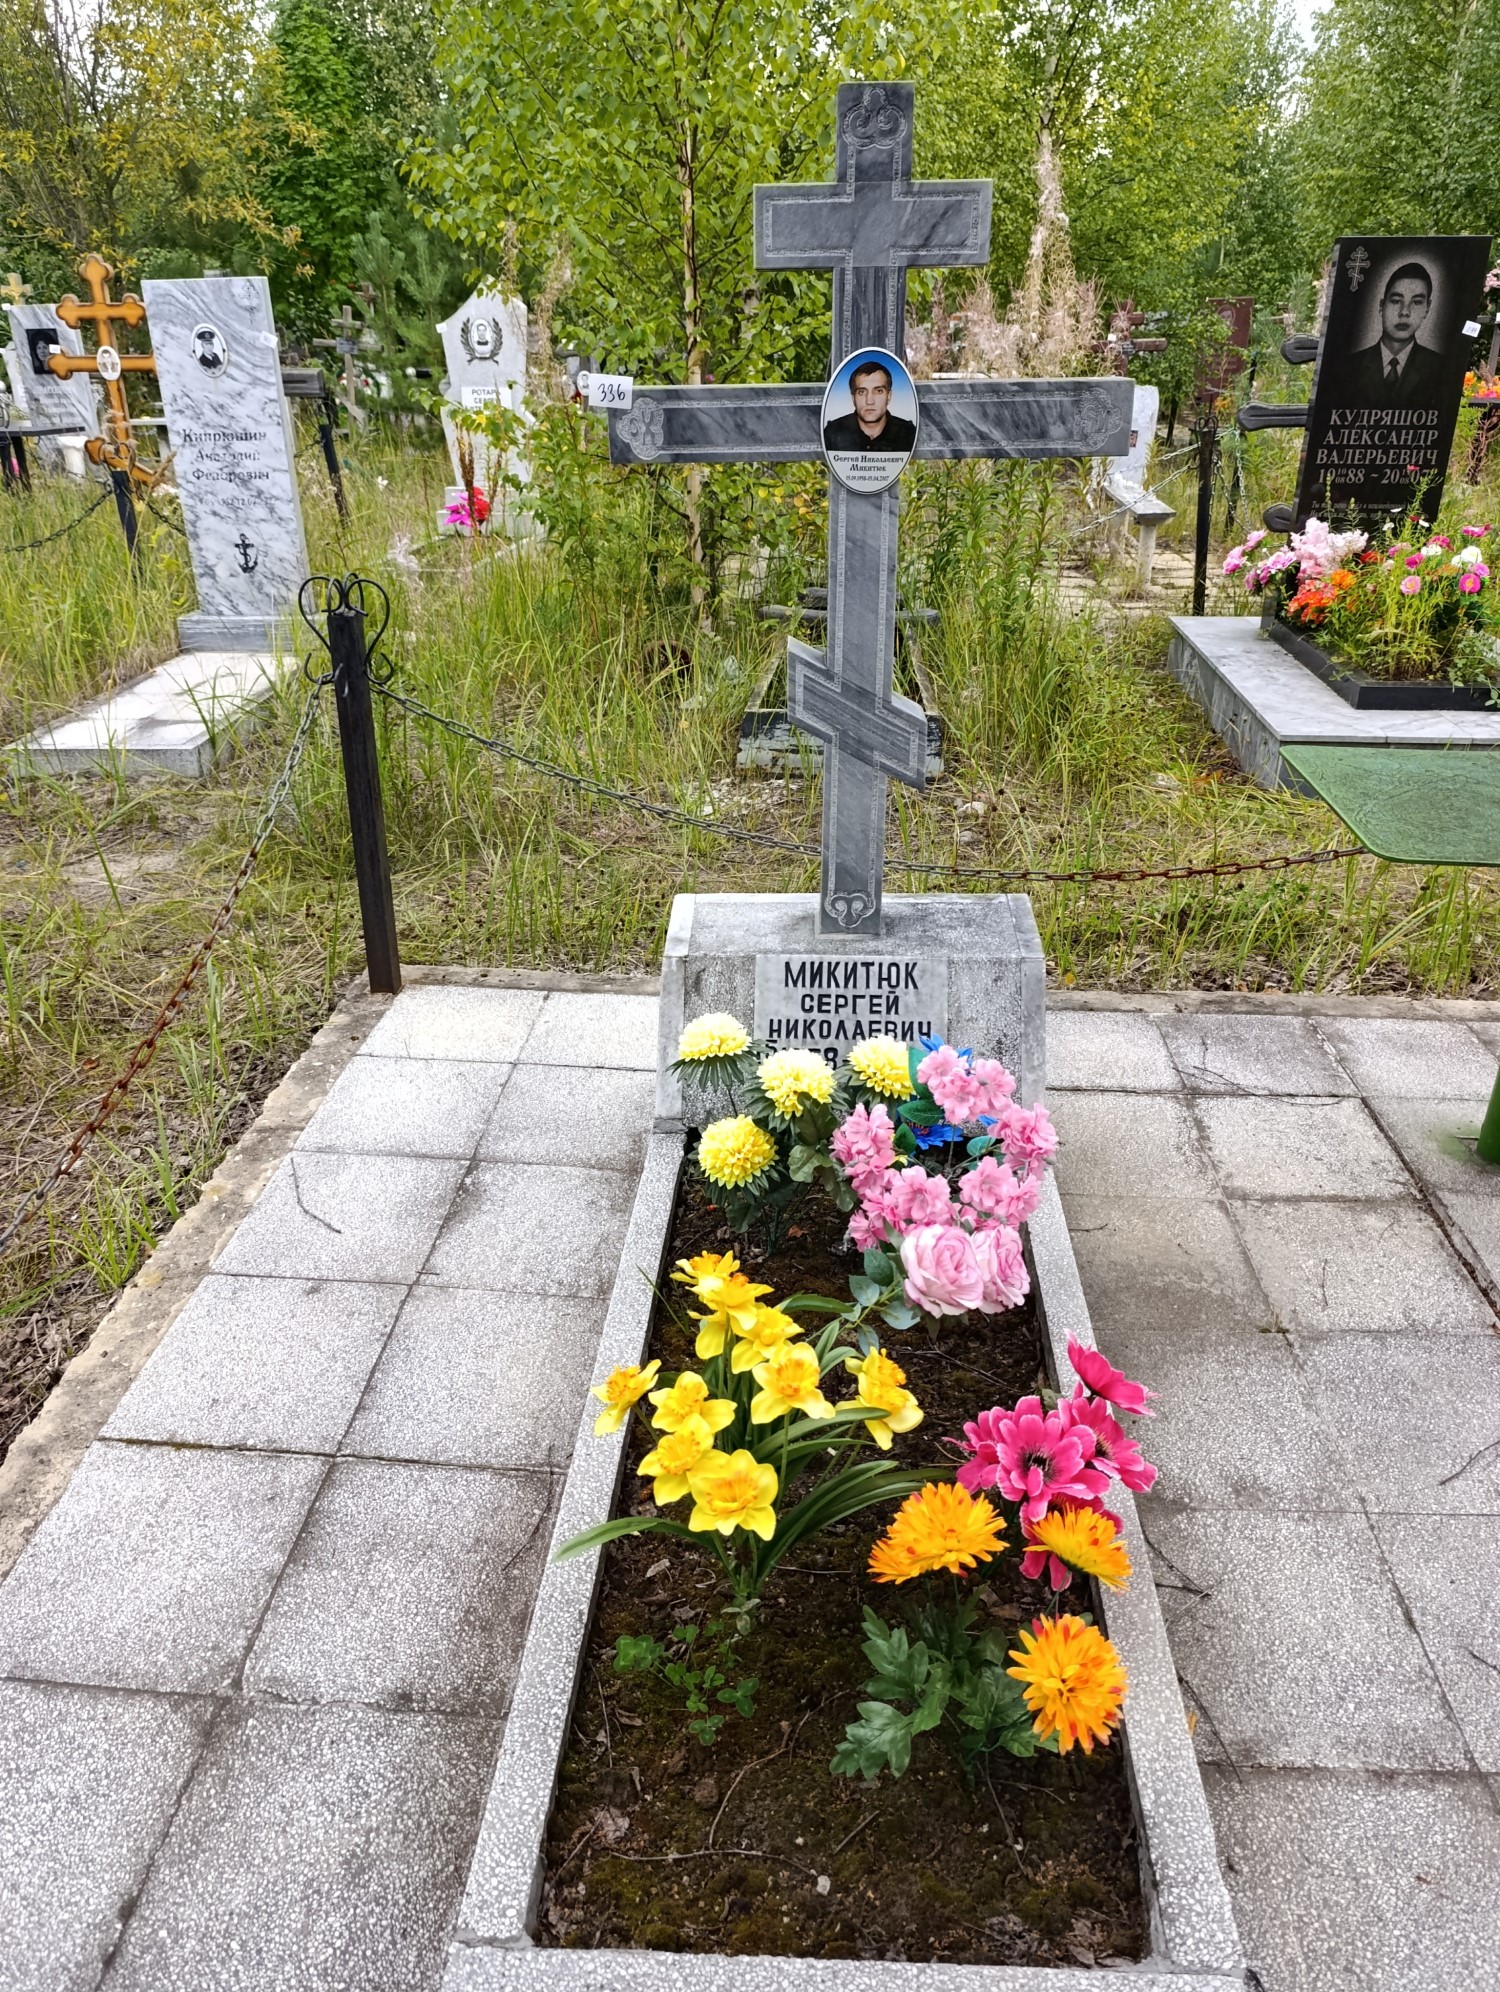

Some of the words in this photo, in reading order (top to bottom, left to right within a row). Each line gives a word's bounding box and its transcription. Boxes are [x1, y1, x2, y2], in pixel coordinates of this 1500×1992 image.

[597, 383, 626, 403] 336
[1329, 409, 1439, 428] КУДРЯШОВ
[1322, 429, 1439, 448] АЛЕКСАНДР
[1315, 448, 1439, 465] ВАЛЕРЬЕВИЧ
[784, 960, 919, 990] МИКИТЮК
[800, 990, 900, 1015] СЕРГЕЙ
[768, 1018, 932, 1042] НИКОЛАЕВИЧ
